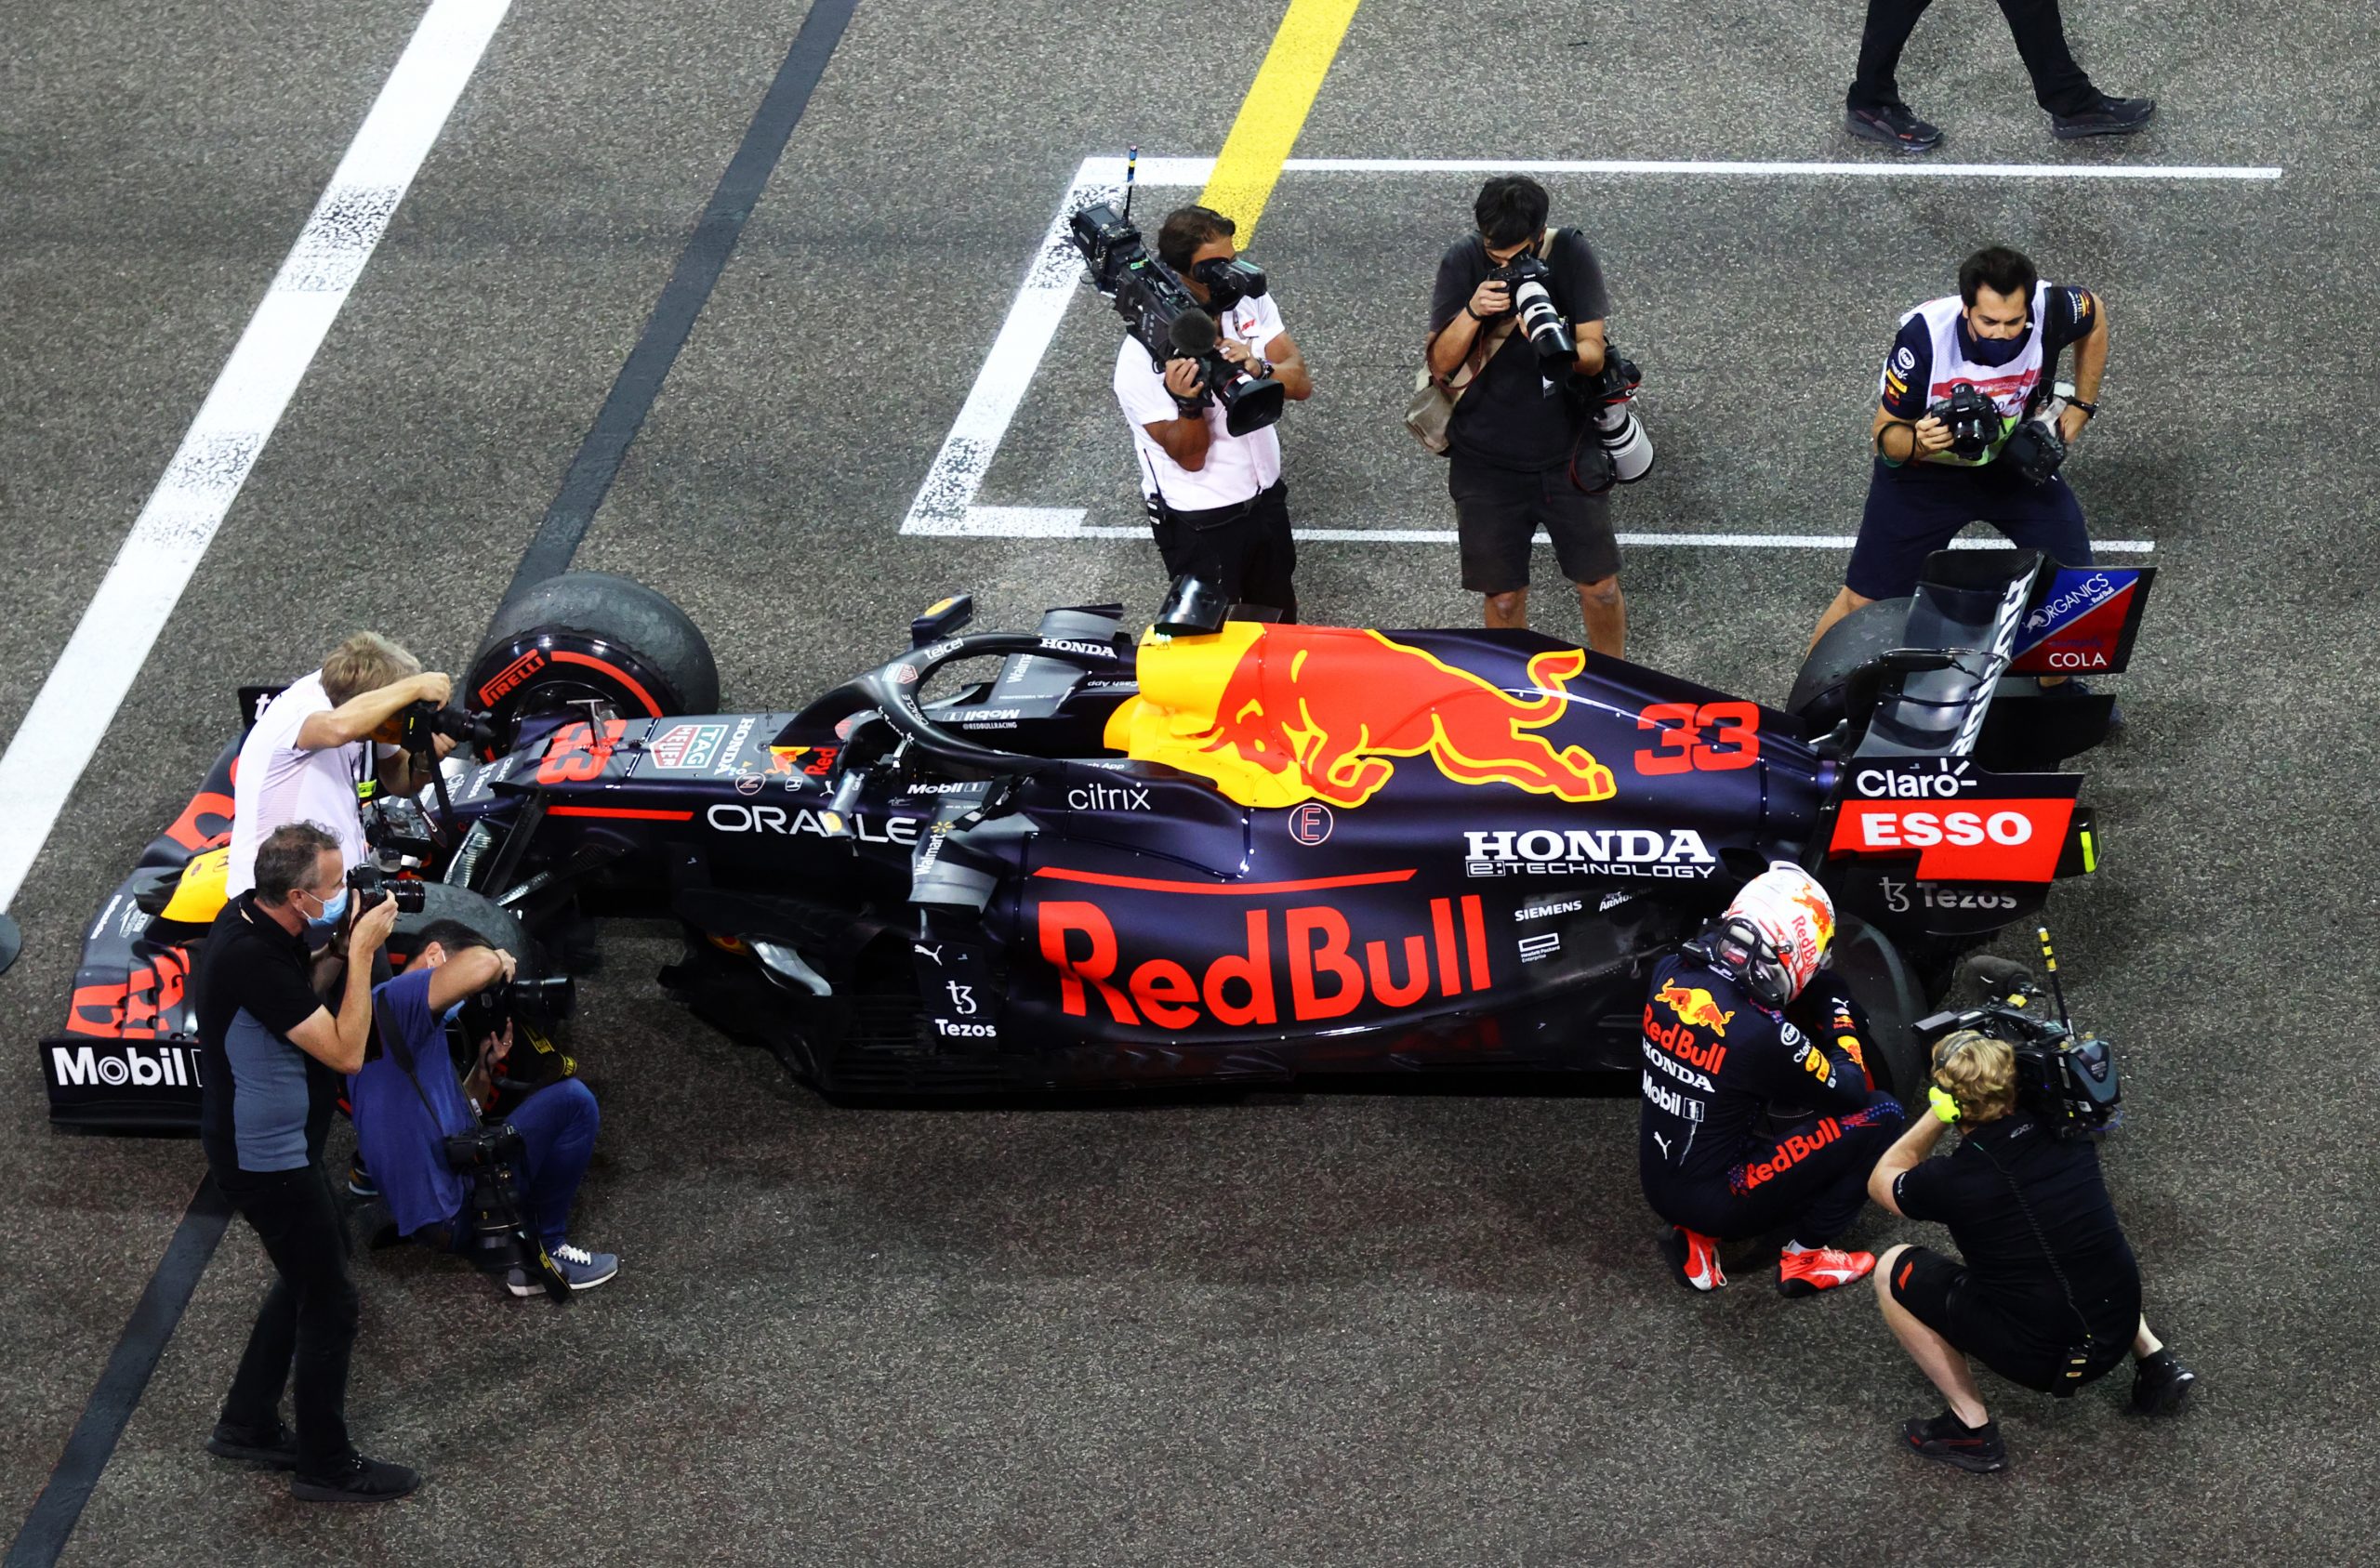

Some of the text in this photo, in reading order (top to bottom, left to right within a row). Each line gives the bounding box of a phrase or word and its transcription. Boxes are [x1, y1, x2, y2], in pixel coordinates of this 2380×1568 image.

[2031, 573, 2109, 627] ORGANICS
[1039, 638, 1117, 659] HONDA
[2048, 652, 2108, 667] COLA
[478, 649, 545, 707] PIRELLI
[658, 726, 687, 767] HEUER
[686, 728, 721, 766] TAG
[713, 718, 756, 775] HONDA
[1633, 701, 1760, 776] 33
[906, 783, 963, 794] Mobil
[1067, 782, 1151, 810] citrix
[1857, 769, 1960, 797] Claro
[1463, 829, 1716, 863] HONDA
[1860, 810, 2033, 847] ESSO
[913, 834, 946, 876] Walmart
[1514, 900, 1582, 921] SIEMENS
[1915, 882, 2018, 909] Tezos
[1521, 945, 1561, 958] Hewlett Packard
[1522, 954, 1547, 963] Enterprise
[934, 1018, 997, 1037] Tezos
[51, 1046, 188, 1087] Mobil
[1643, 1035, 1715, 1093] HONDA
[1643, 1069, 1682, 1116] Mobil
